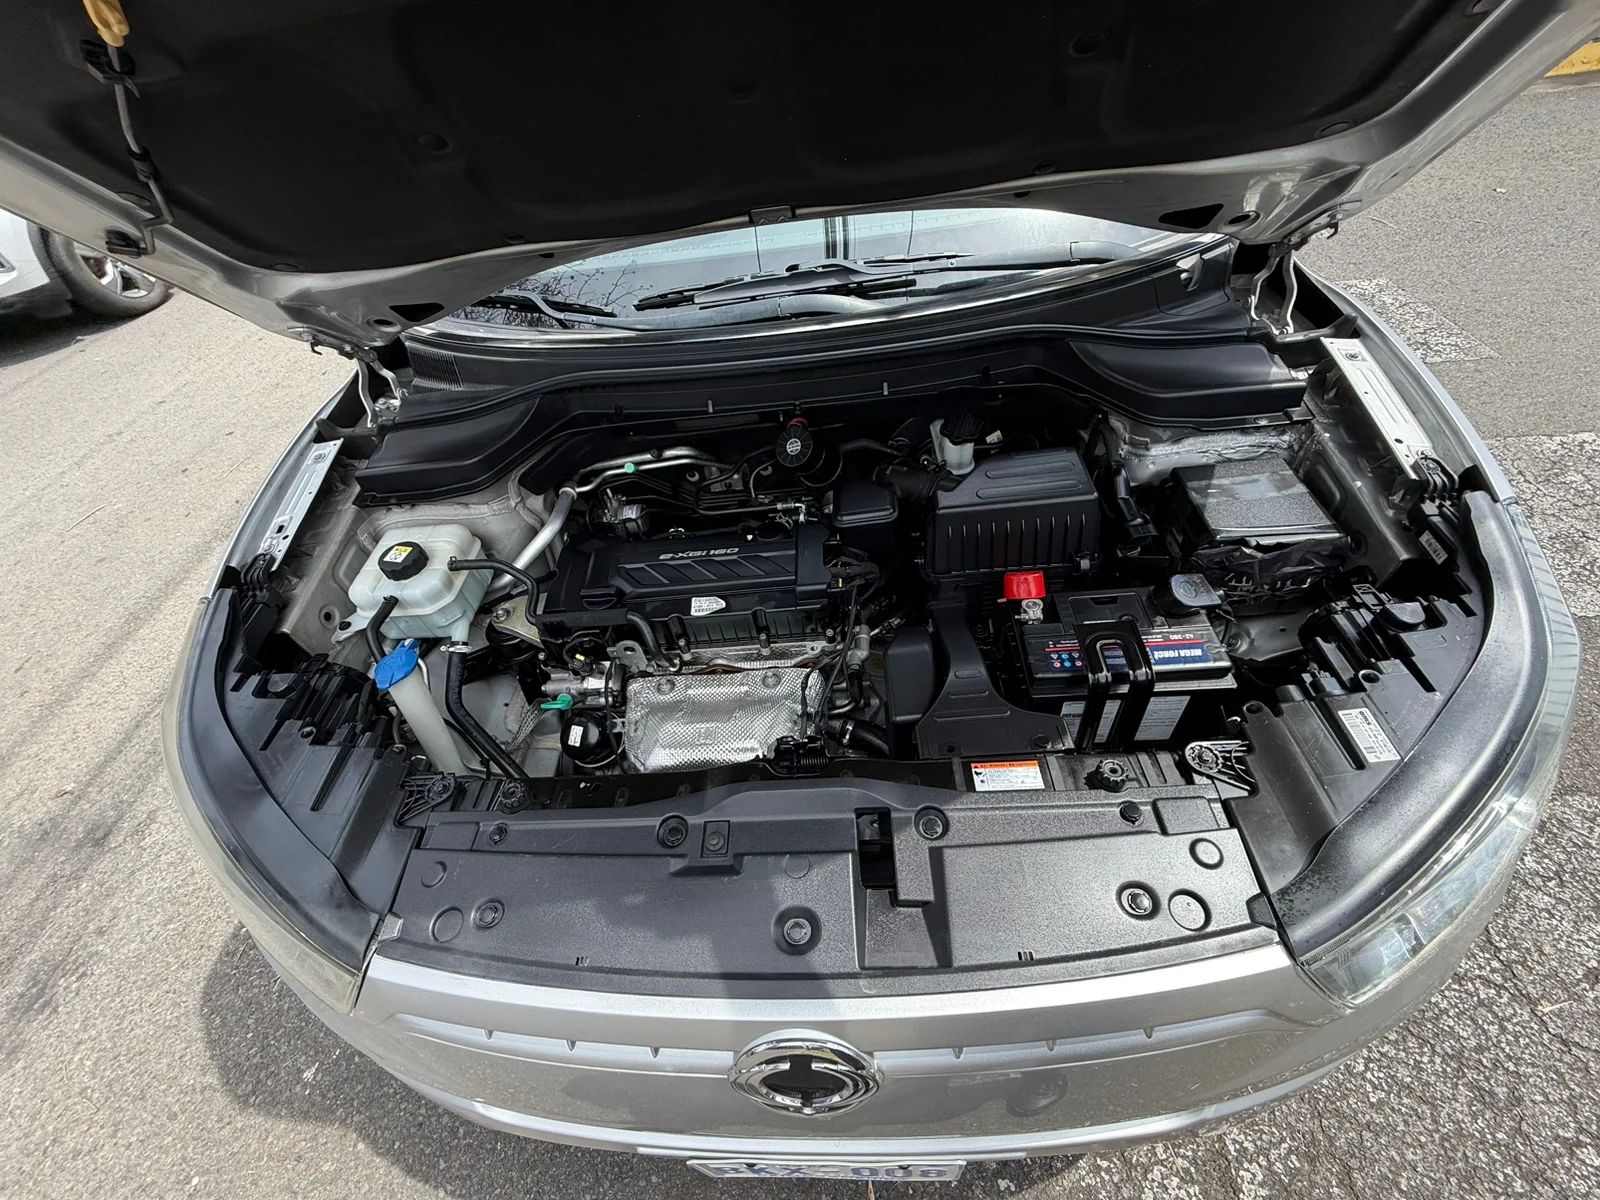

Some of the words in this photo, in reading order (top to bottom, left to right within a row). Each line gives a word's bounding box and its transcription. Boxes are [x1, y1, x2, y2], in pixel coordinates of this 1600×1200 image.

[709, 547, 739, 555] 160
[1153, 649, 1178, 660] FORCE
[1178, 648, 1203, 658] MEGA
